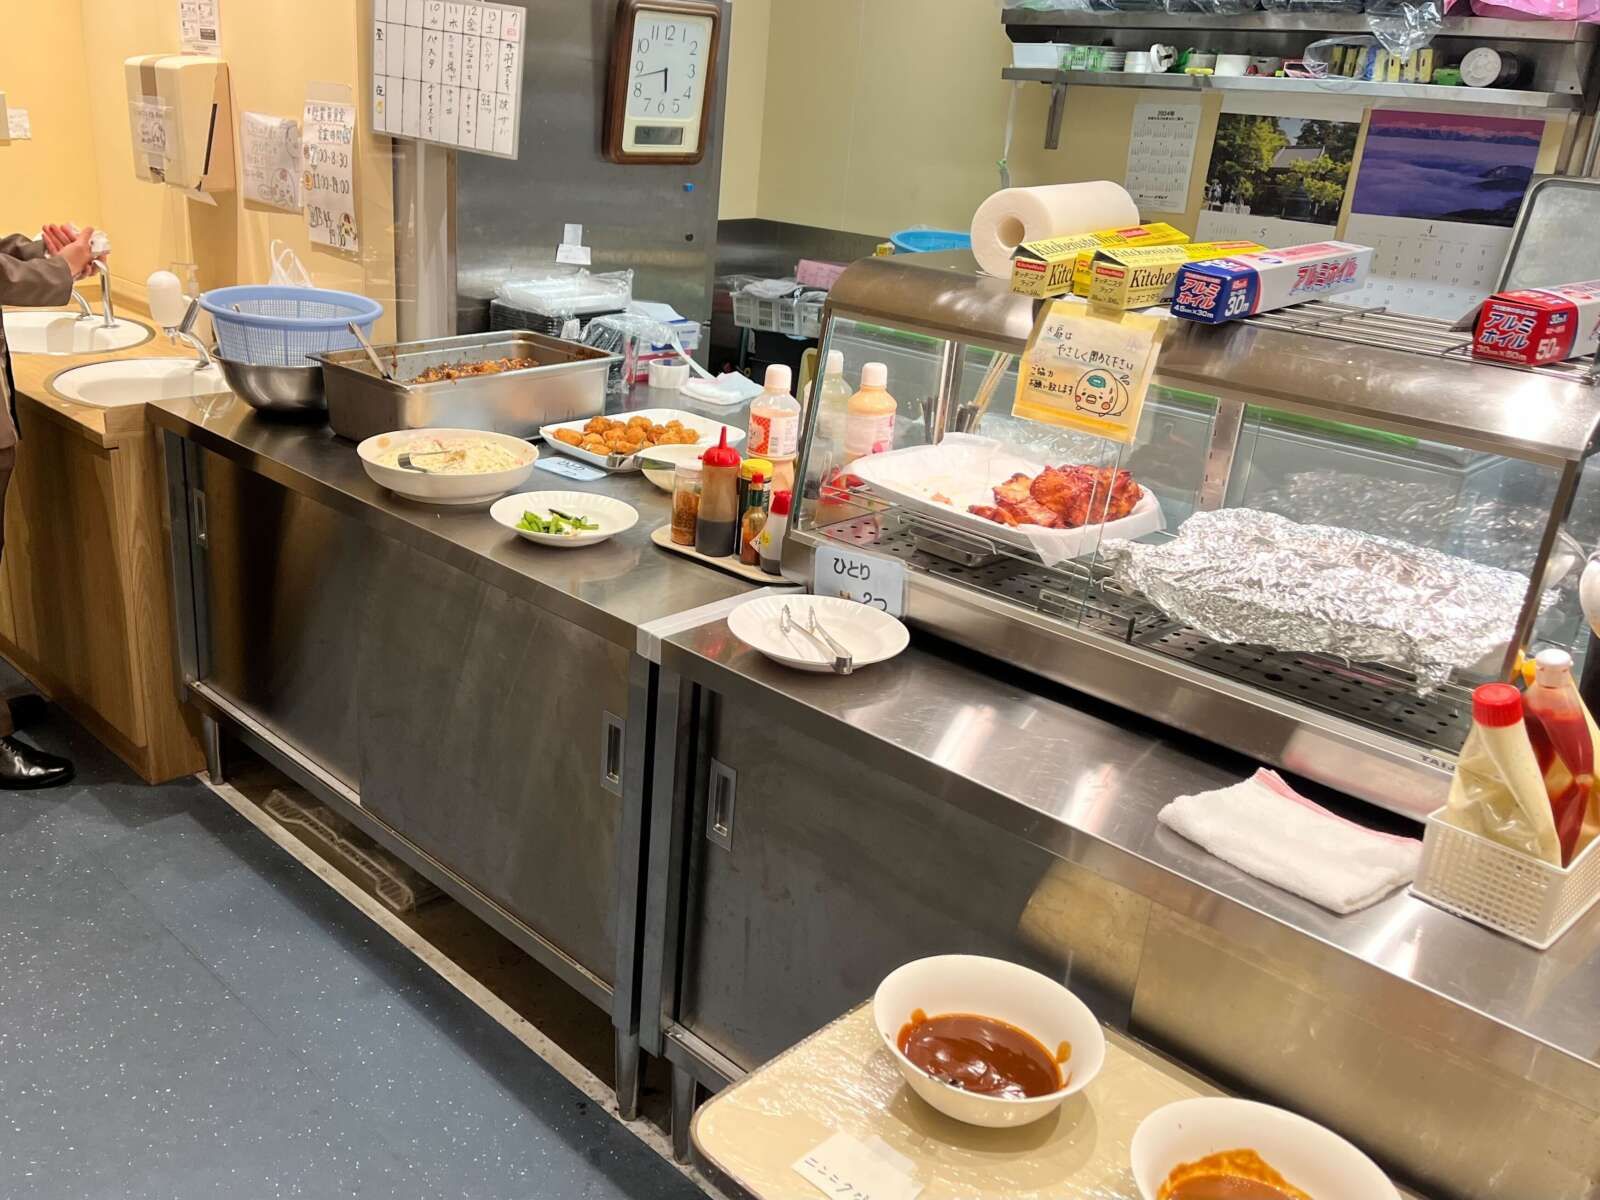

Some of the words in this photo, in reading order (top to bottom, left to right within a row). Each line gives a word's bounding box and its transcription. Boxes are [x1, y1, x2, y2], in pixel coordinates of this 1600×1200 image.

[467, 7, 478, 16] 12
[651, 25, 660, 41] 11
[664, 24, 676, 41] 12
[682, 28, 687, 43] 1
[637, 38, 650, 54] 10
[689, 40, 698, 56] 2
[635, 60, 644, 74] 9
[687, 63, 696, 79] 3
[633, 82, 642, 98] 8
[683, 86, 692, 99] 4
[643, 98, 652, 112] 7
[657, 99, 665, 114] 6
[672, 98, 680, 114] 5
[1259, 228, 1268, 239] 5
[1292, 257, 1357, 290] アルミホイル
[1180, 278, 1221, 297] アルミ
[1176, 291, 1216, 310] ホイル
[1224, 294, 1249, 317] 30m
[1484, 311, 1536, 334] アルミ
[1479, 329, 1530, 350] ホイル
[1056, 343, 1134, 371] やさしく閉めて下さい
[833, 557, 871, 581] ひとり
[862, 591, 888, 612] 2つ
[1420, 755, 1456, 771] TAIJ
